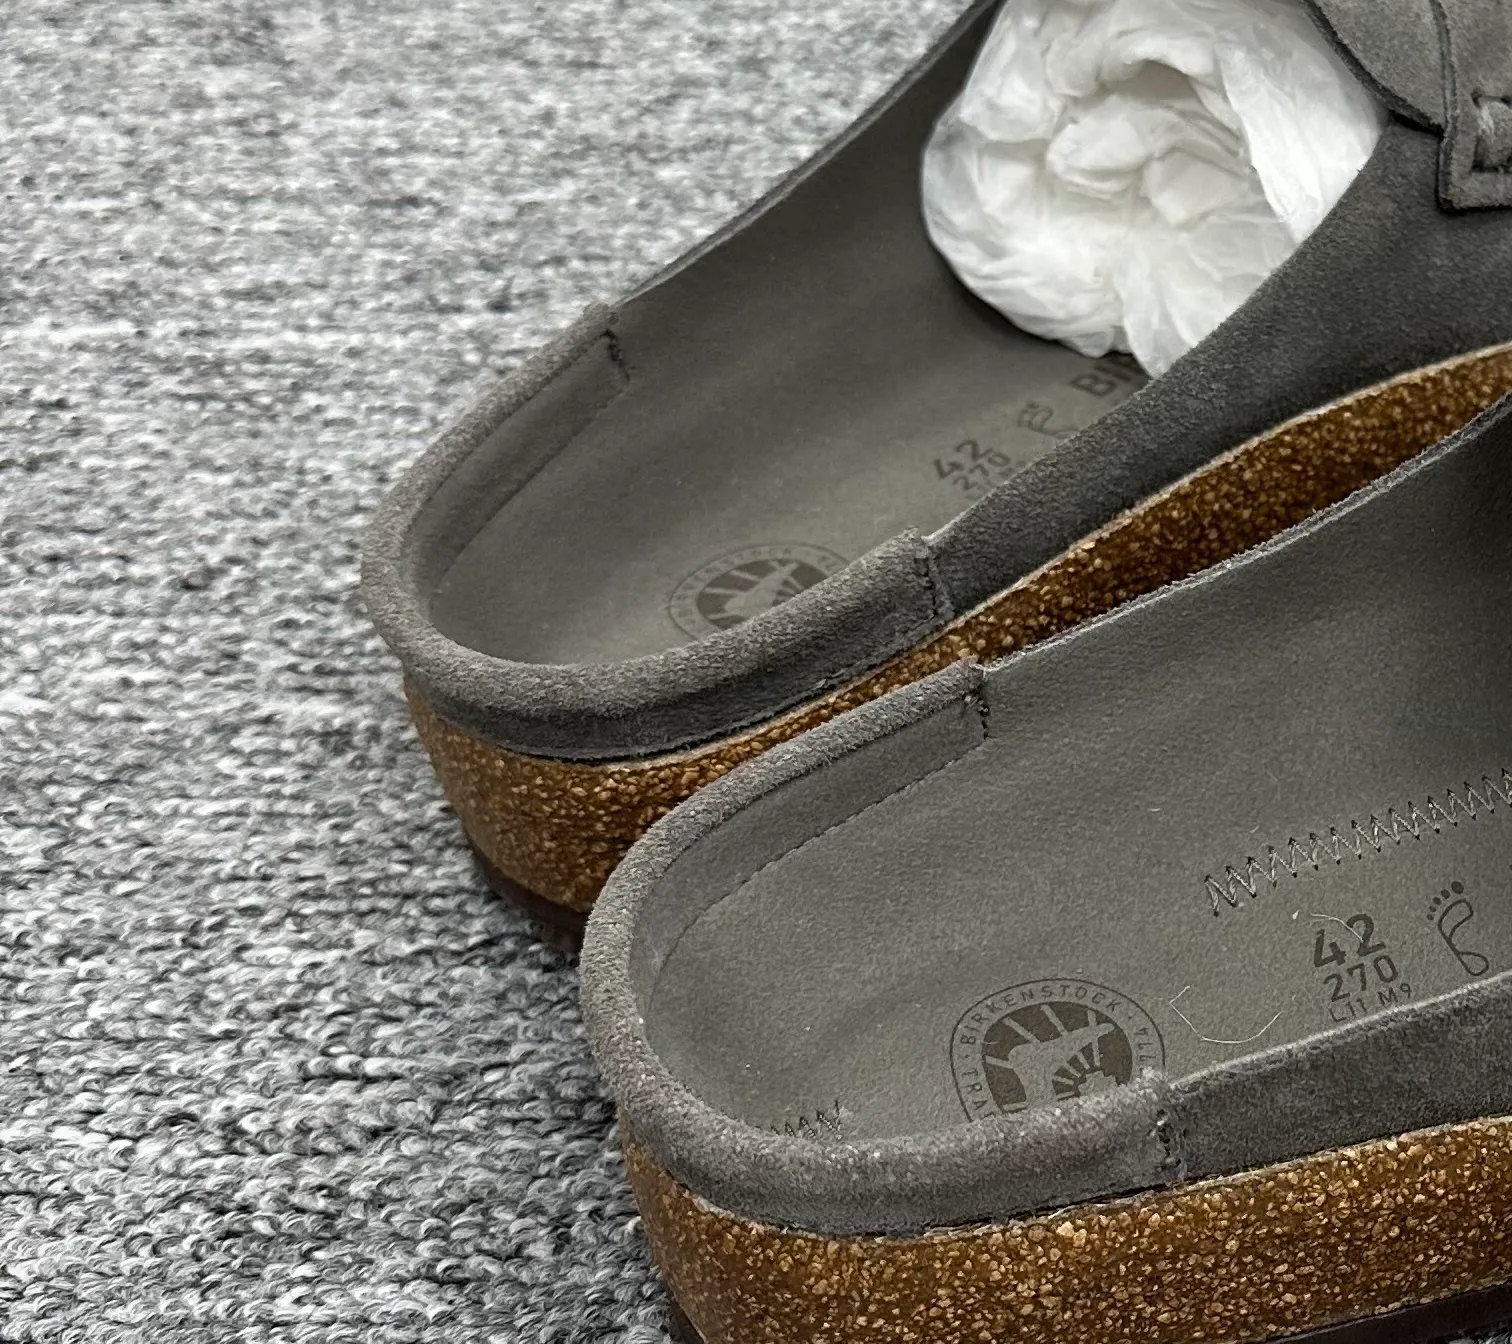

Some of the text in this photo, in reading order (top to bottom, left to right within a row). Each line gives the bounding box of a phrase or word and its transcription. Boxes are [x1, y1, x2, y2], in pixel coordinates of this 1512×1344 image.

[933, 440, 994, 479] 42
[1314, 914, 1387, 968] 42
[1323, 955, 1399, 1003] 270
[960, 984, 1122, 1045] BIRKENSTOCK
